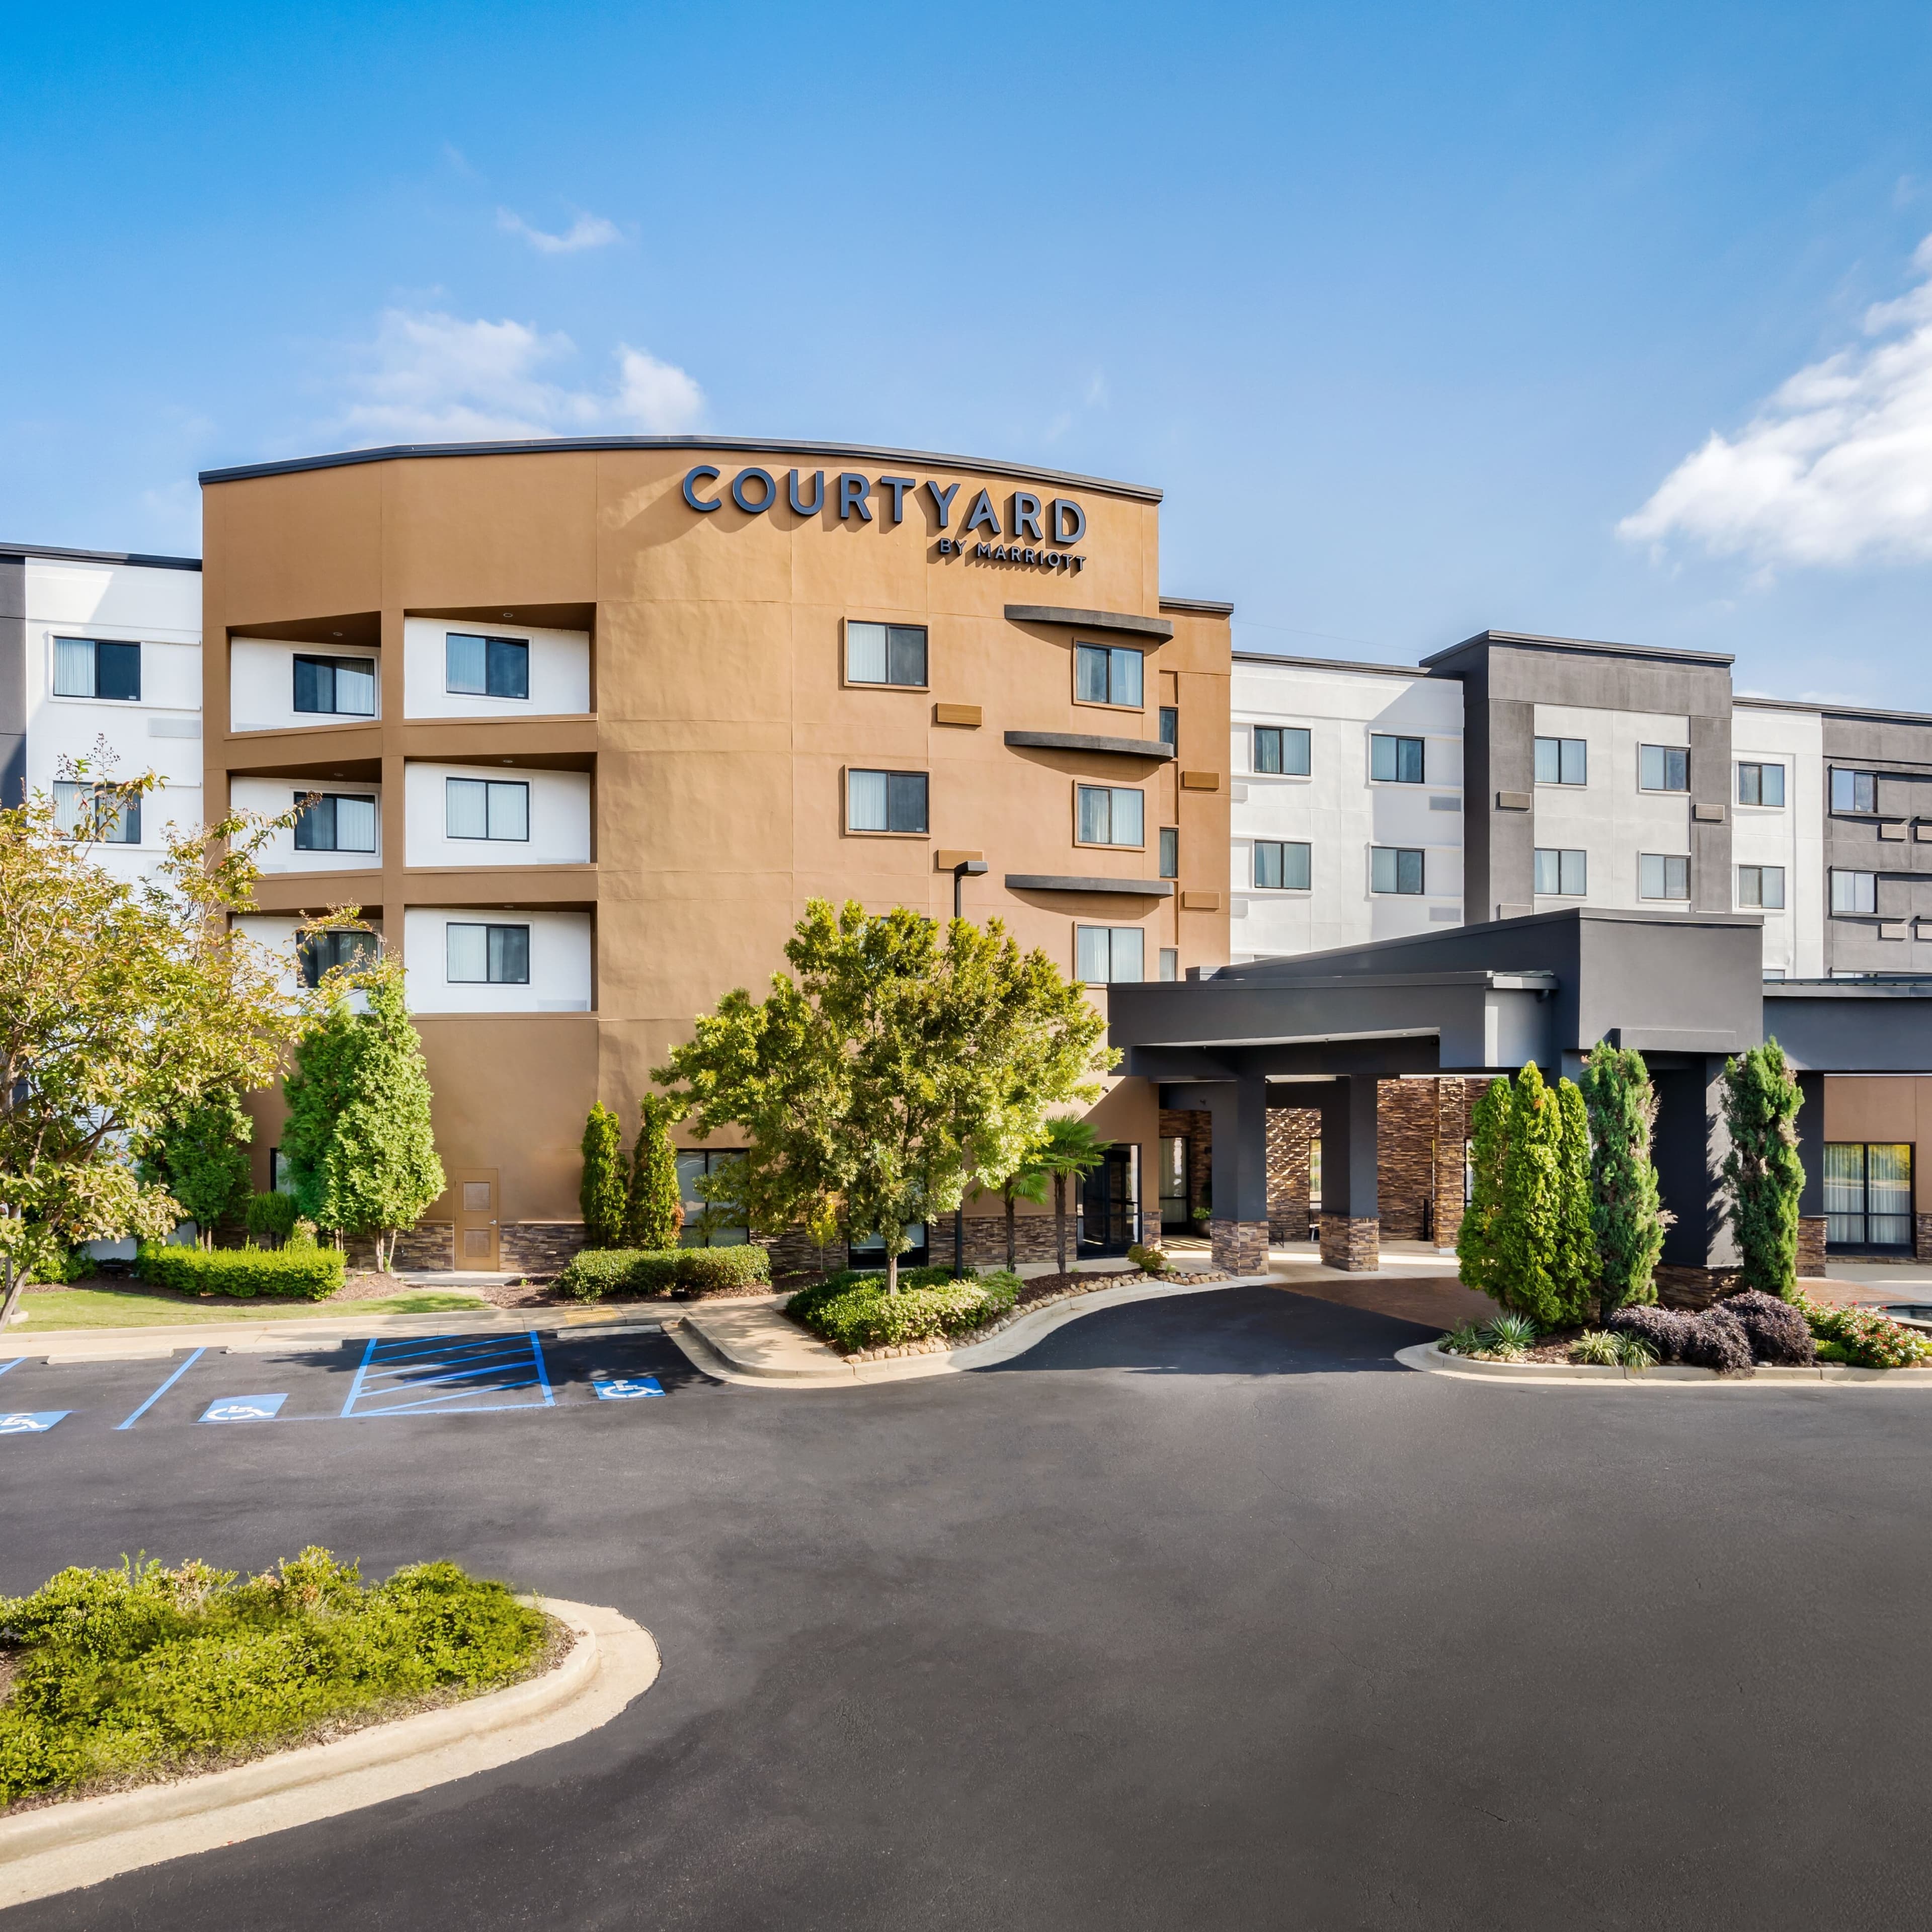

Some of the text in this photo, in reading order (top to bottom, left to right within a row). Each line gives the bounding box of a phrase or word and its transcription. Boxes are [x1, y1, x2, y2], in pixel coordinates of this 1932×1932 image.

[683, 465, 1086, 543] COURTYARD
[940, 537, 1086, 571] BY MARRIOTT
